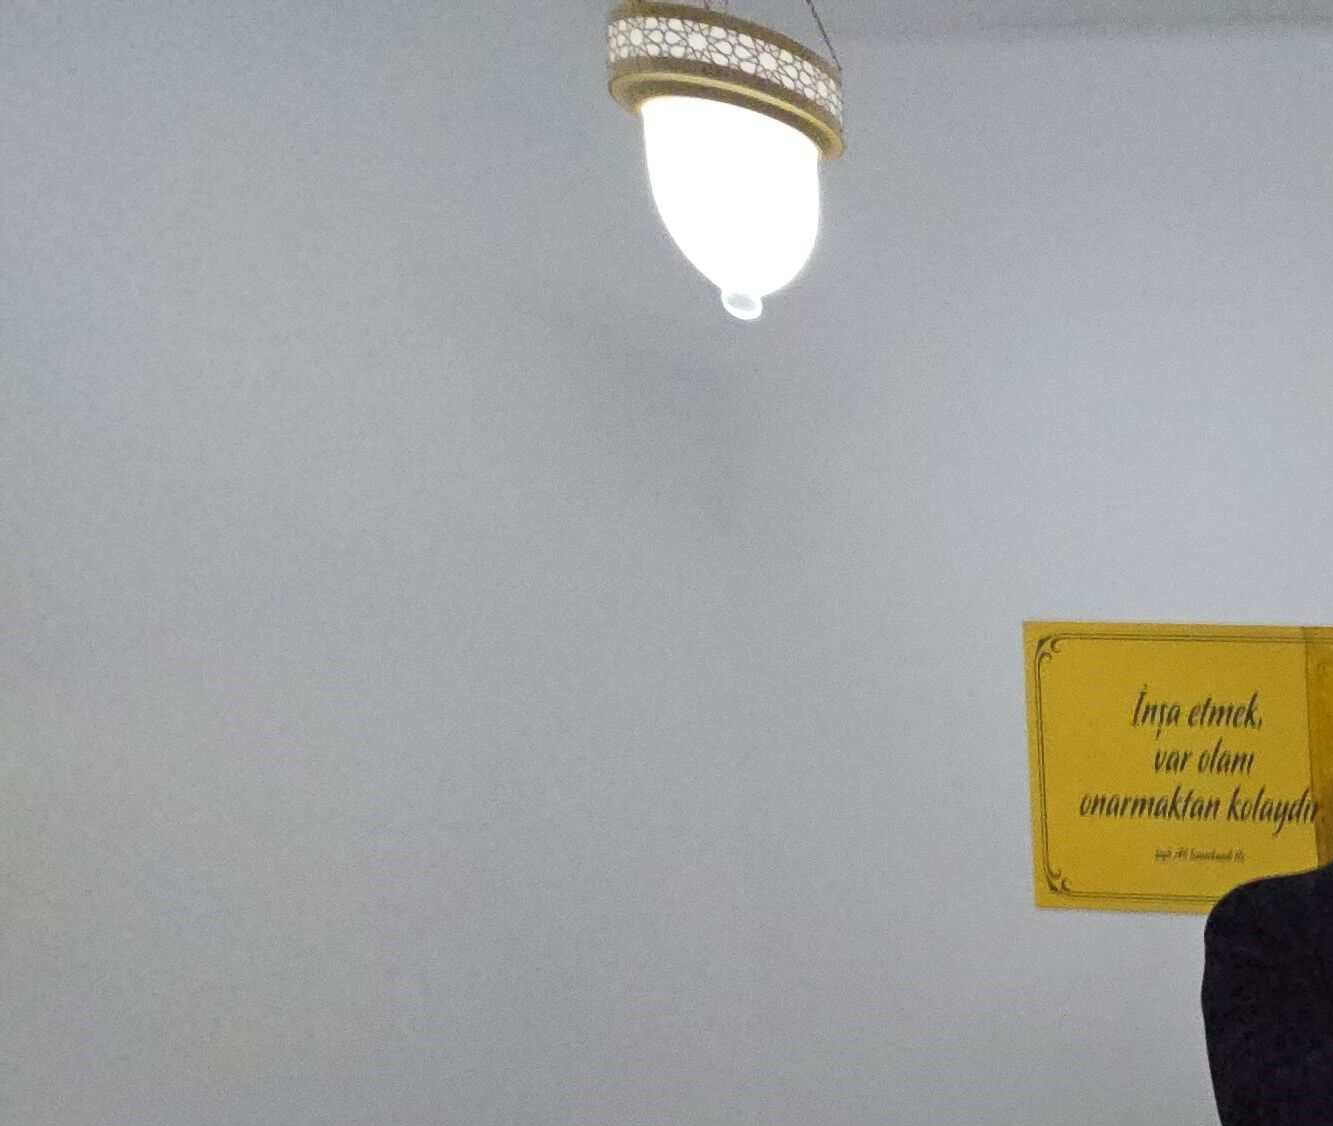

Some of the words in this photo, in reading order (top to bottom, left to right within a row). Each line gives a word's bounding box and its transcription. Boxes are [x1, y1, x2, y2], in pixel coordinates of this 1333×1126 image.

[1131, 684, 1181, 740] İnşa
[1187, 691, 1263, 731] etmek,
[1154, 749, 1193, 774] var
[1197, 736, 1255, 776] olanı
[1079, 784, 1221, 820] onarmaktan
